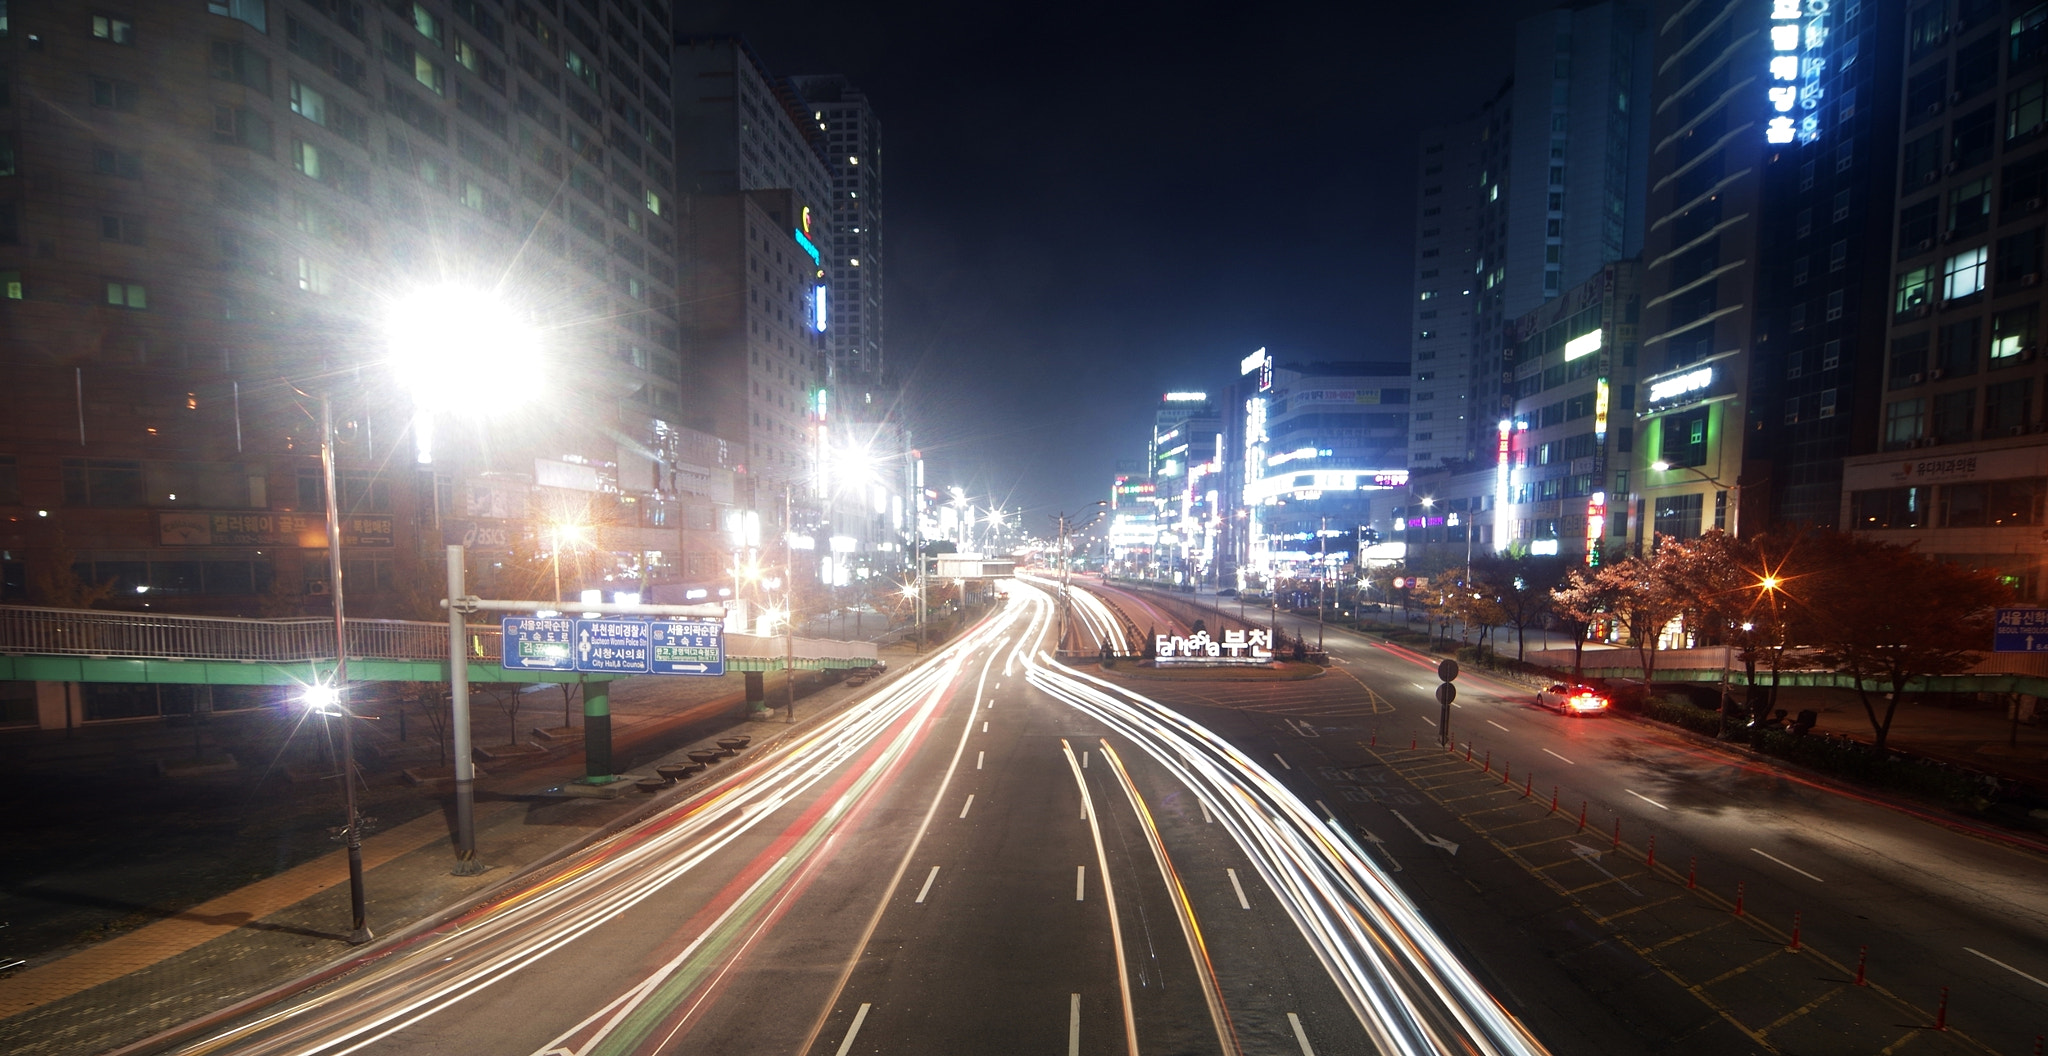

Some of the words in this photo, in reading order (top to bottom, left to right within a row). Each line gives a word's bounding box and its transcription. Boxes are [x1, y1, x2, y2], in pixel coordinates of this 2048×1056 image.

[1917, 457, 1976, 476] 유디치과의원
[1998, 611, 2048, 626] 서울신학
[519, 620, 570, 632] 서울외곽순환
[591, 623, 647, 638] 부천원미경찰서
[667, 624, 719, 637] 서울외곽순환
[591, 636, 610, 645] Bucheon
[626, 638, 639, 647] Police
[1221, 628, 1273, 657] 부천
[592, 660, 604, 668] City
